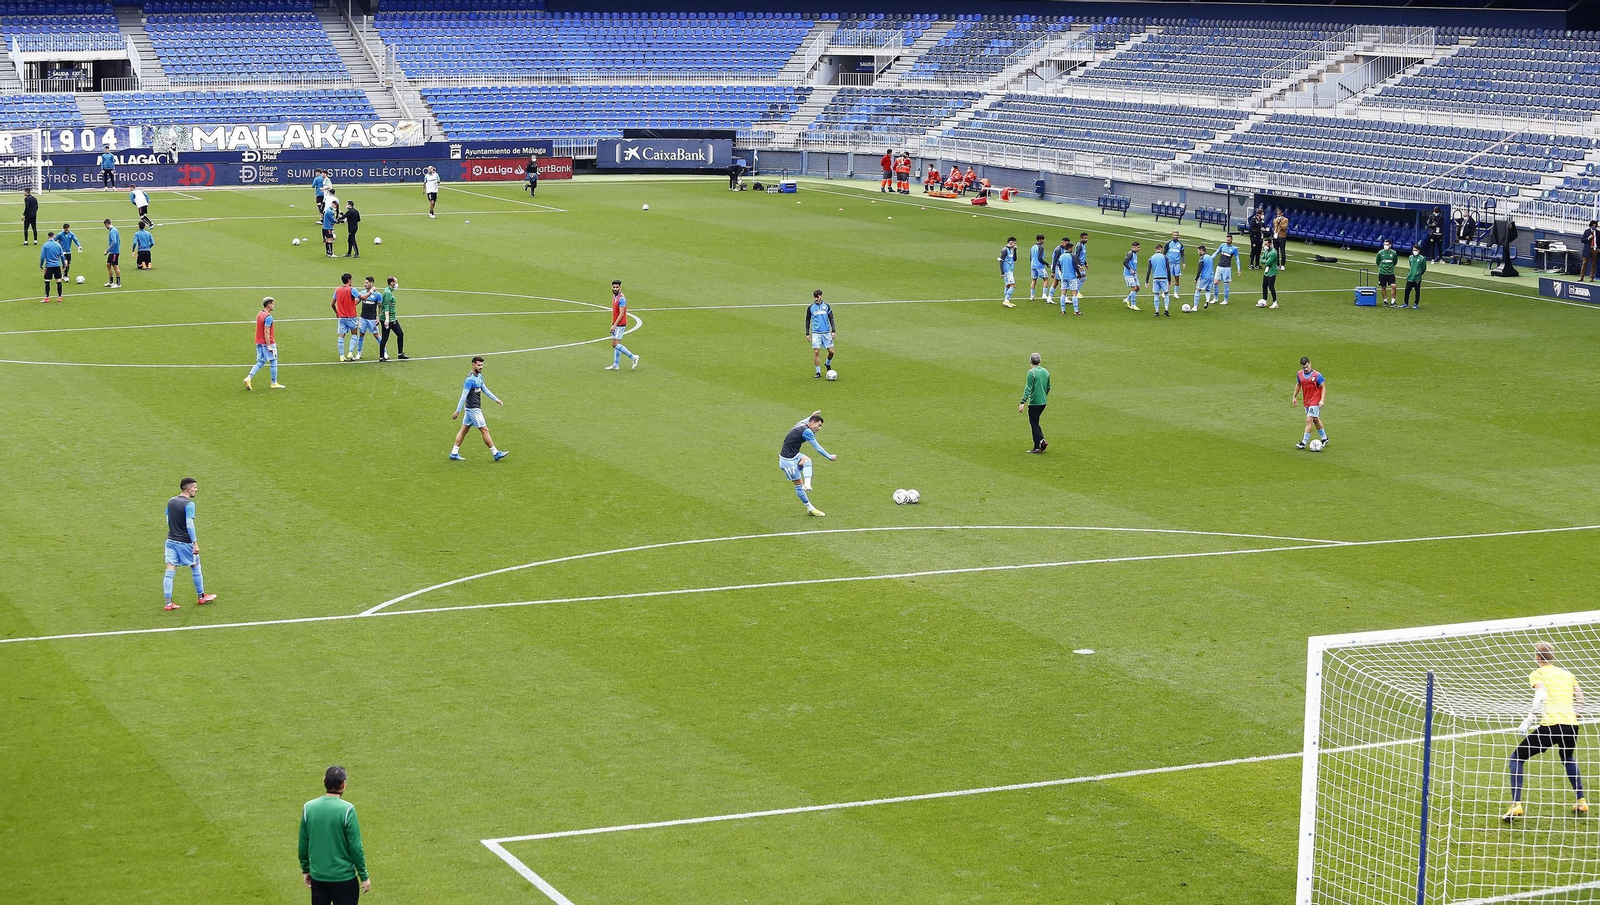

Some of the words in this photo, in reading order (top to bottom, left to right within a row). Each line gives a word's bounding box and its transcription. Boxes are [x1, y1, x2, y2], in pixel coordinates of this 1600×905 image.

[43, 128, 117, 152] 1904
[190, 122, 395, 151] MALAKAS
[465, 148, 510, 156] Ayuntamiento
[522, 147, 546, 155] Málaga
[642, 147, 706, 161] CaixaBank
[287, 168, 363, 178] SUMISTROS
[484, 164, 513, 175] LaLiga
[536, 164, 572, 174] artBank
[0, 173, 77, 184] SUMINSTROS
[83, 171, 155, 183] ELTRICOS
